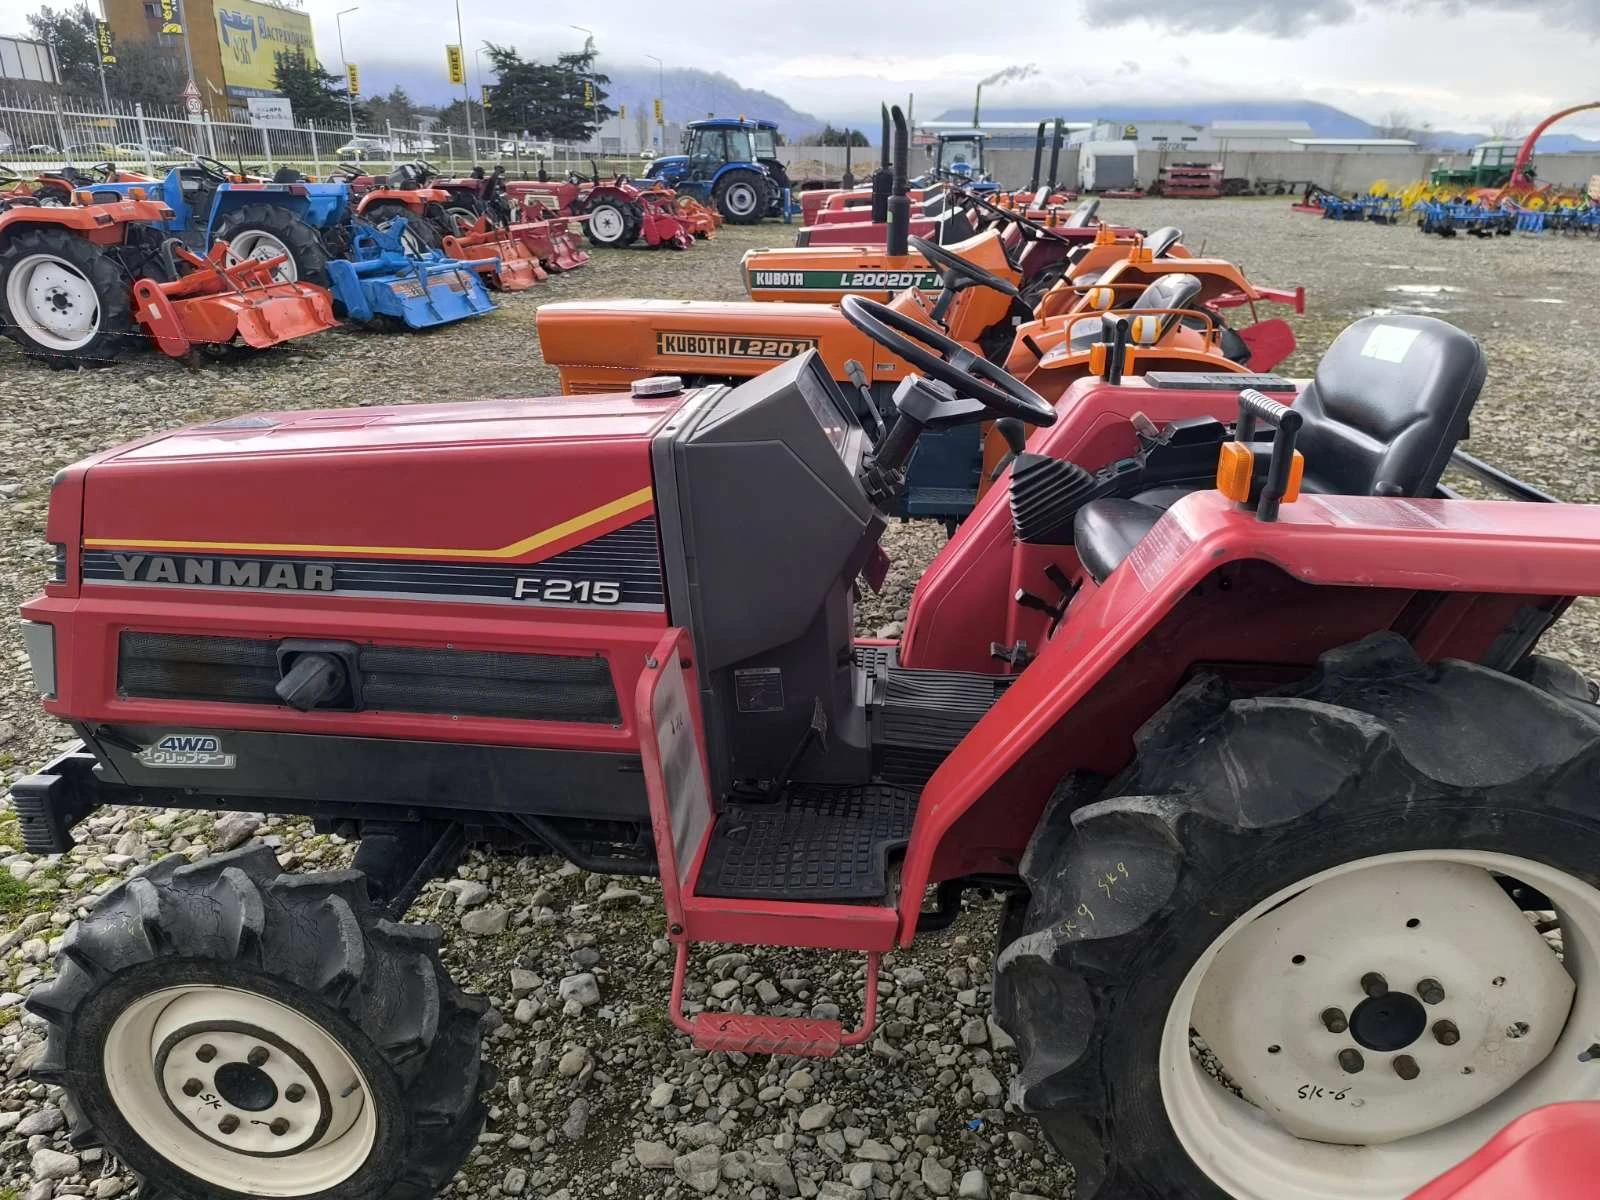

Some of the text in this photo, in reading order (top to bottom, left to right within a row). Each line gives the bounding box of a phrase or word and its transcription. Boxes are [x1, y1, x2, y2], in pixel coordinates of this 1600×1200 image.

[756, 272, 804, 286] KUBOTA
[665, 335, 807, 357] KUBOTA L2201
[113, 554, 336, 591] YANMAR
[514, 577, 621, 603] F215
[159, 736, 219, 752] 4WD
